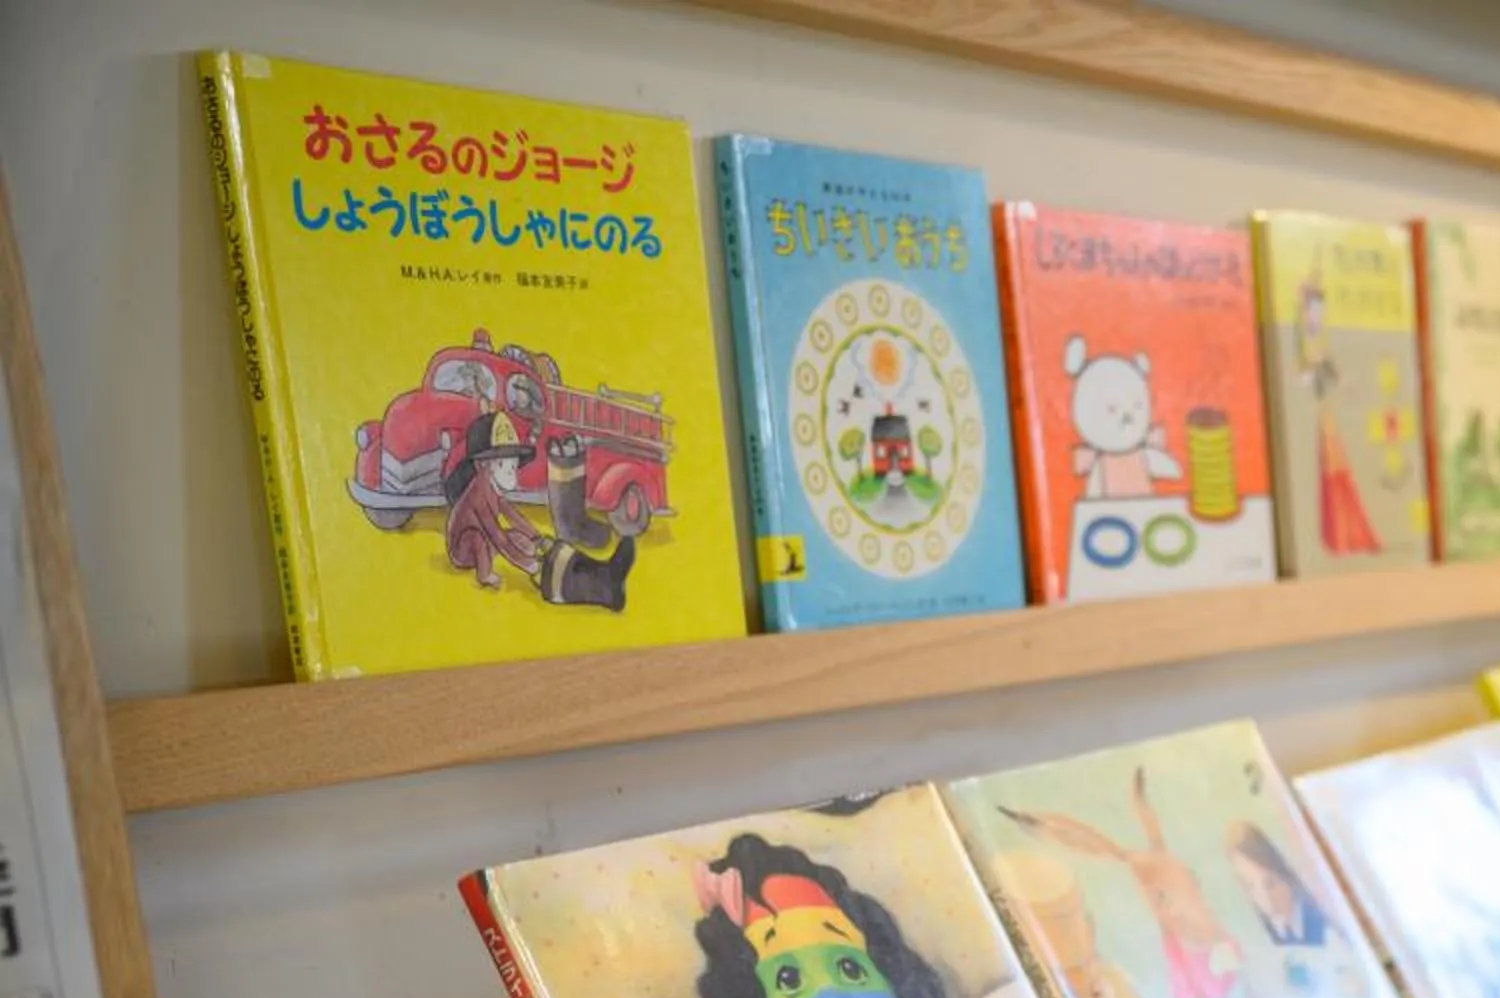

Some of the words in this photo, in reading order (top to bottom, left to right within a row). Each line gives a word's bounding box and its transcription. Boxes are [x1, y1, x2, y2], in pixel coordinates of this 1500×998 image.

[303, 103, 636, 193] おさるのジョージ
[292, 178, 662, 258] しょうぼうしゃにのる
